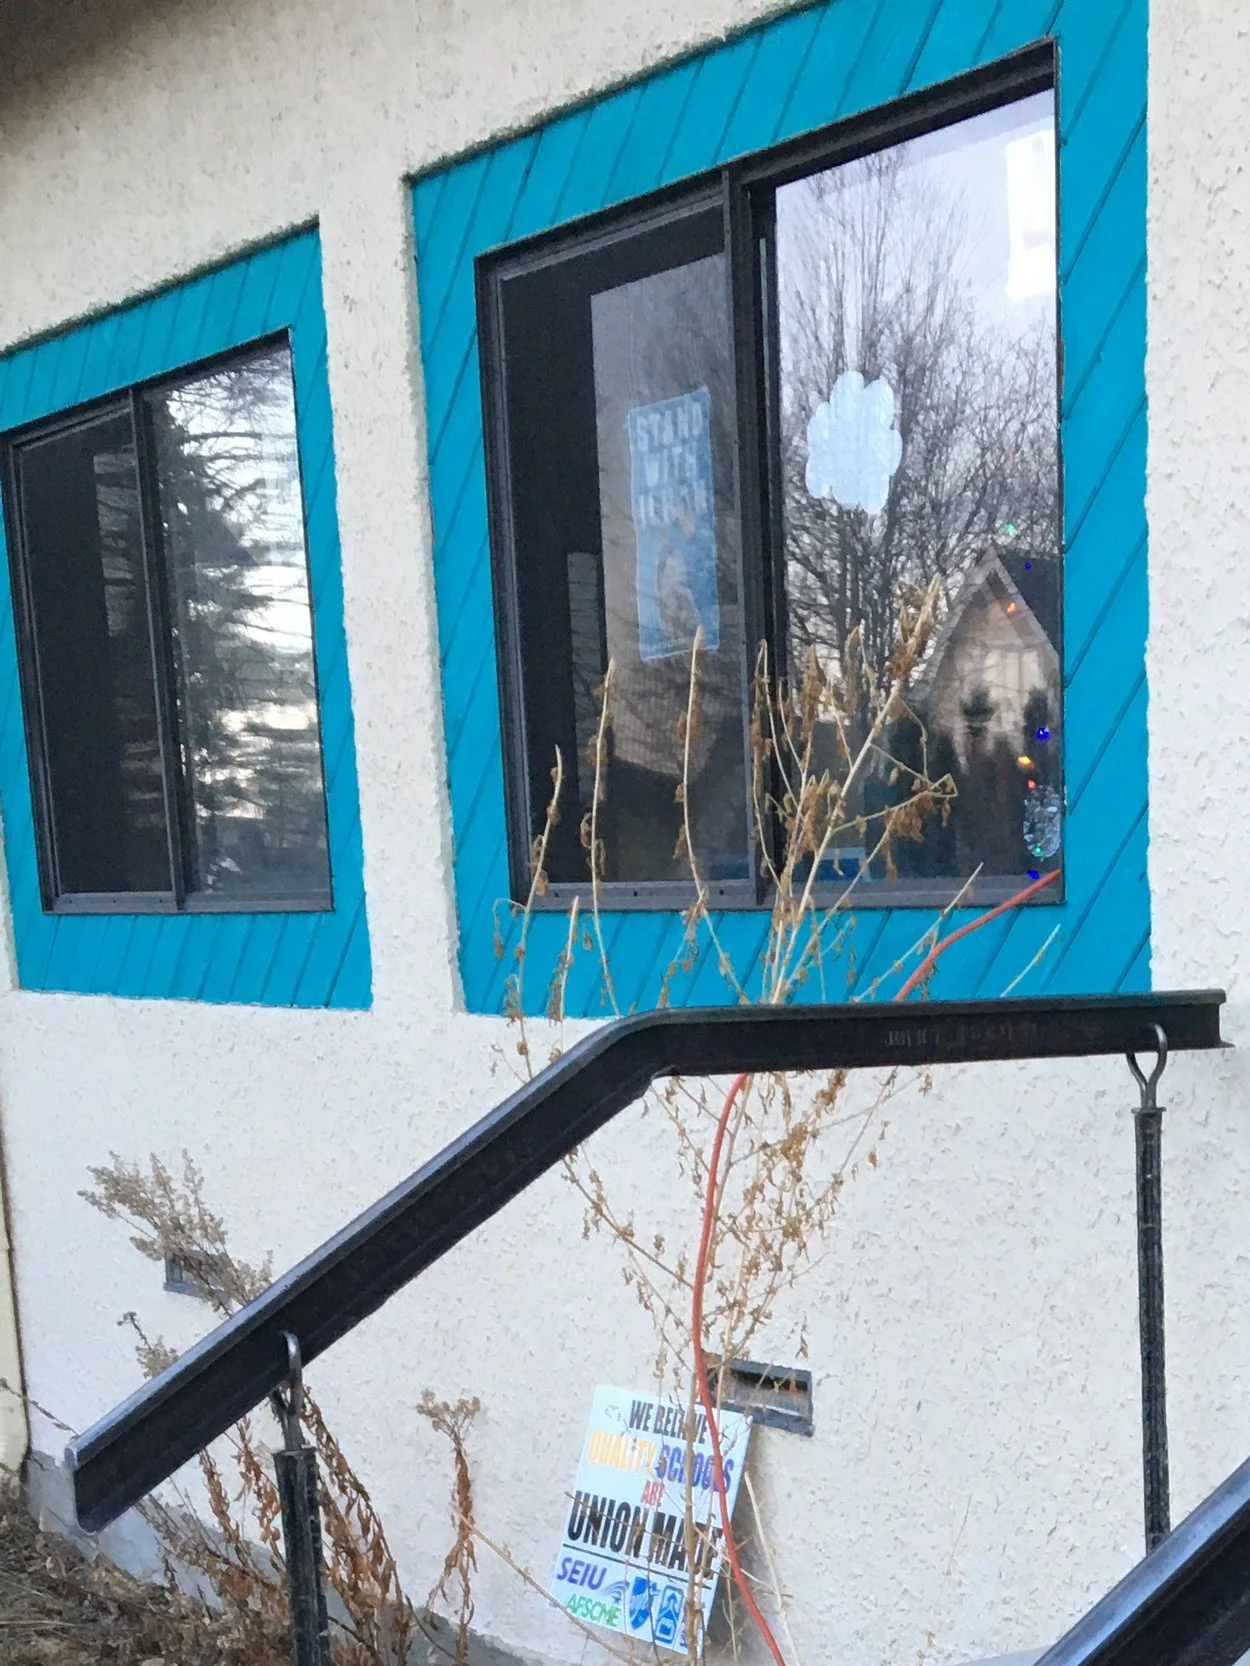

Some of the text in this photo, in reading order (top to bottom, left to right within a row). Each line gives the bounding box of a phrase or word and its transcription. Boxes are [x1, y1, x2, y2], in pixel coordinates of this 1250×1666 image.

[636, 402, 703, 451] STAND
[629, 1400, 653, 1432] WE
[588, 1430, 656, 1473] QUALITY
[641, 1480, 666, 1507] ARE
[567, 1490, 649, 1558] UNION
[557, 1557, 607, 1590] SEIU
[566, 1593, 622, 1628] AFSCME
